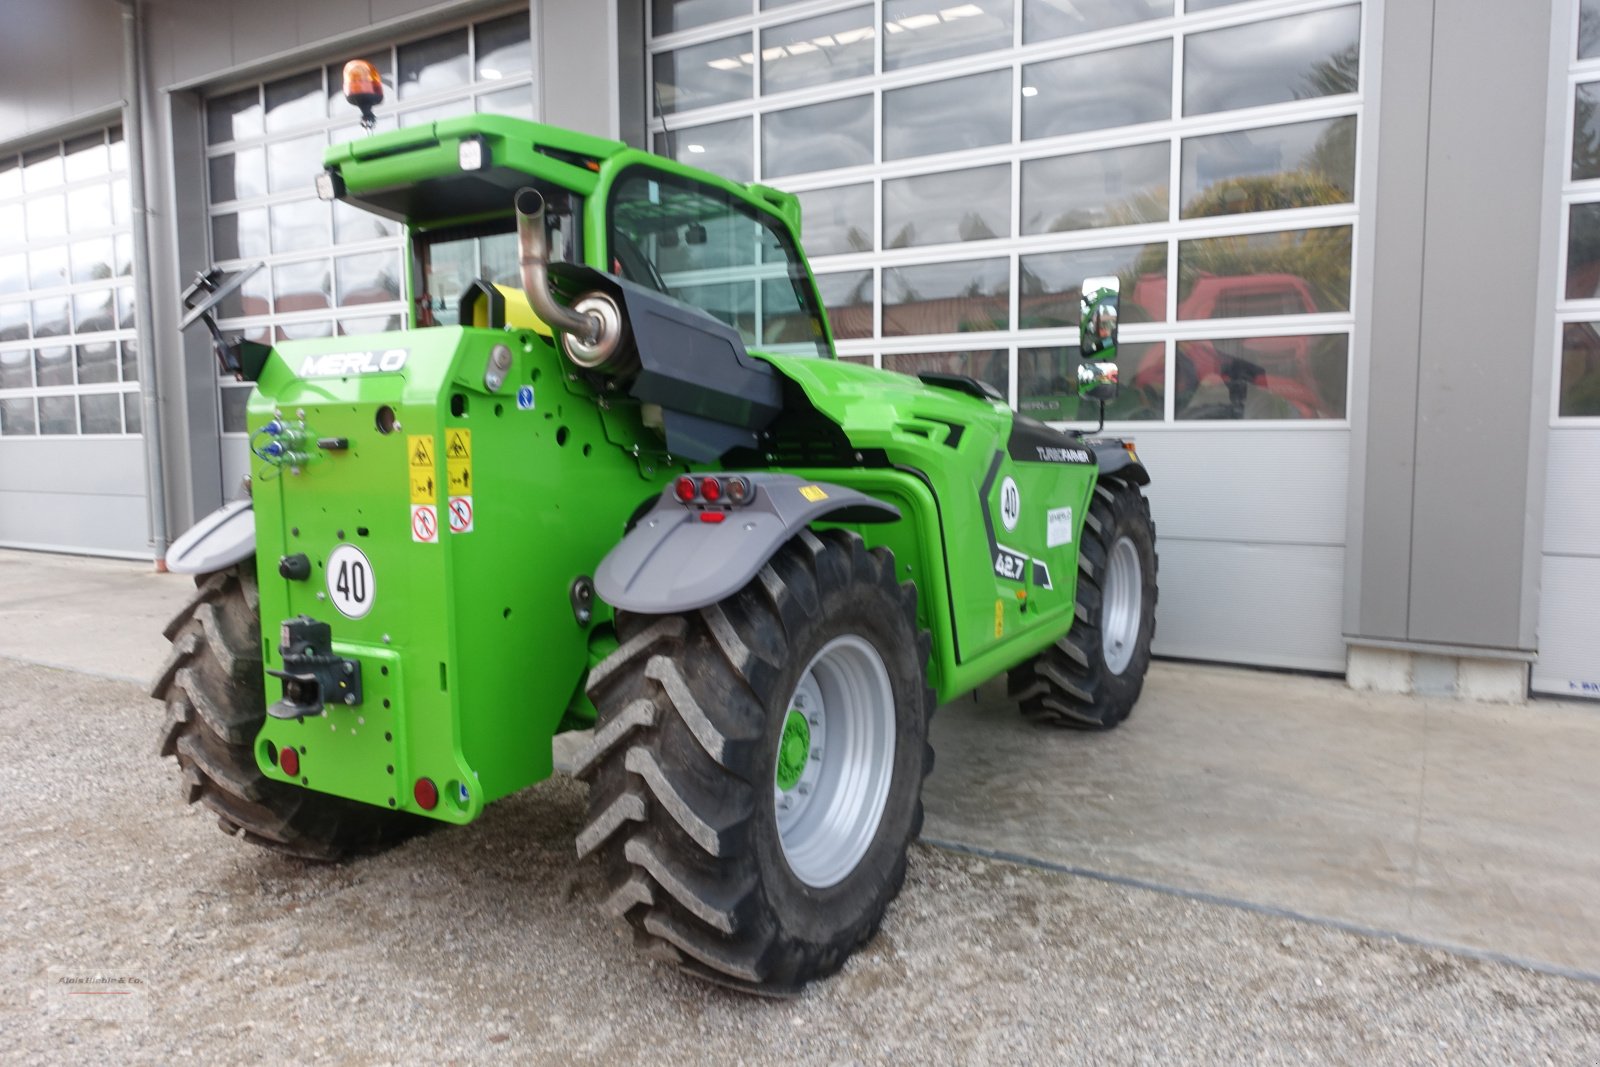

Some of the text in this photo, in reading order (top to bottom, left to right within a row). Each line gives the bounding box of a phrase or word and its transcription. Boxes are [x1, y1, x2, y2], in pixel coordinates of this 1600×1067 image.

[299, 348, 407, 376] MERLO
[1004, 487, 1017, 520] 40
[336, 560, 366, 602] 40
[995, 552, 1024, 580] 42.7
